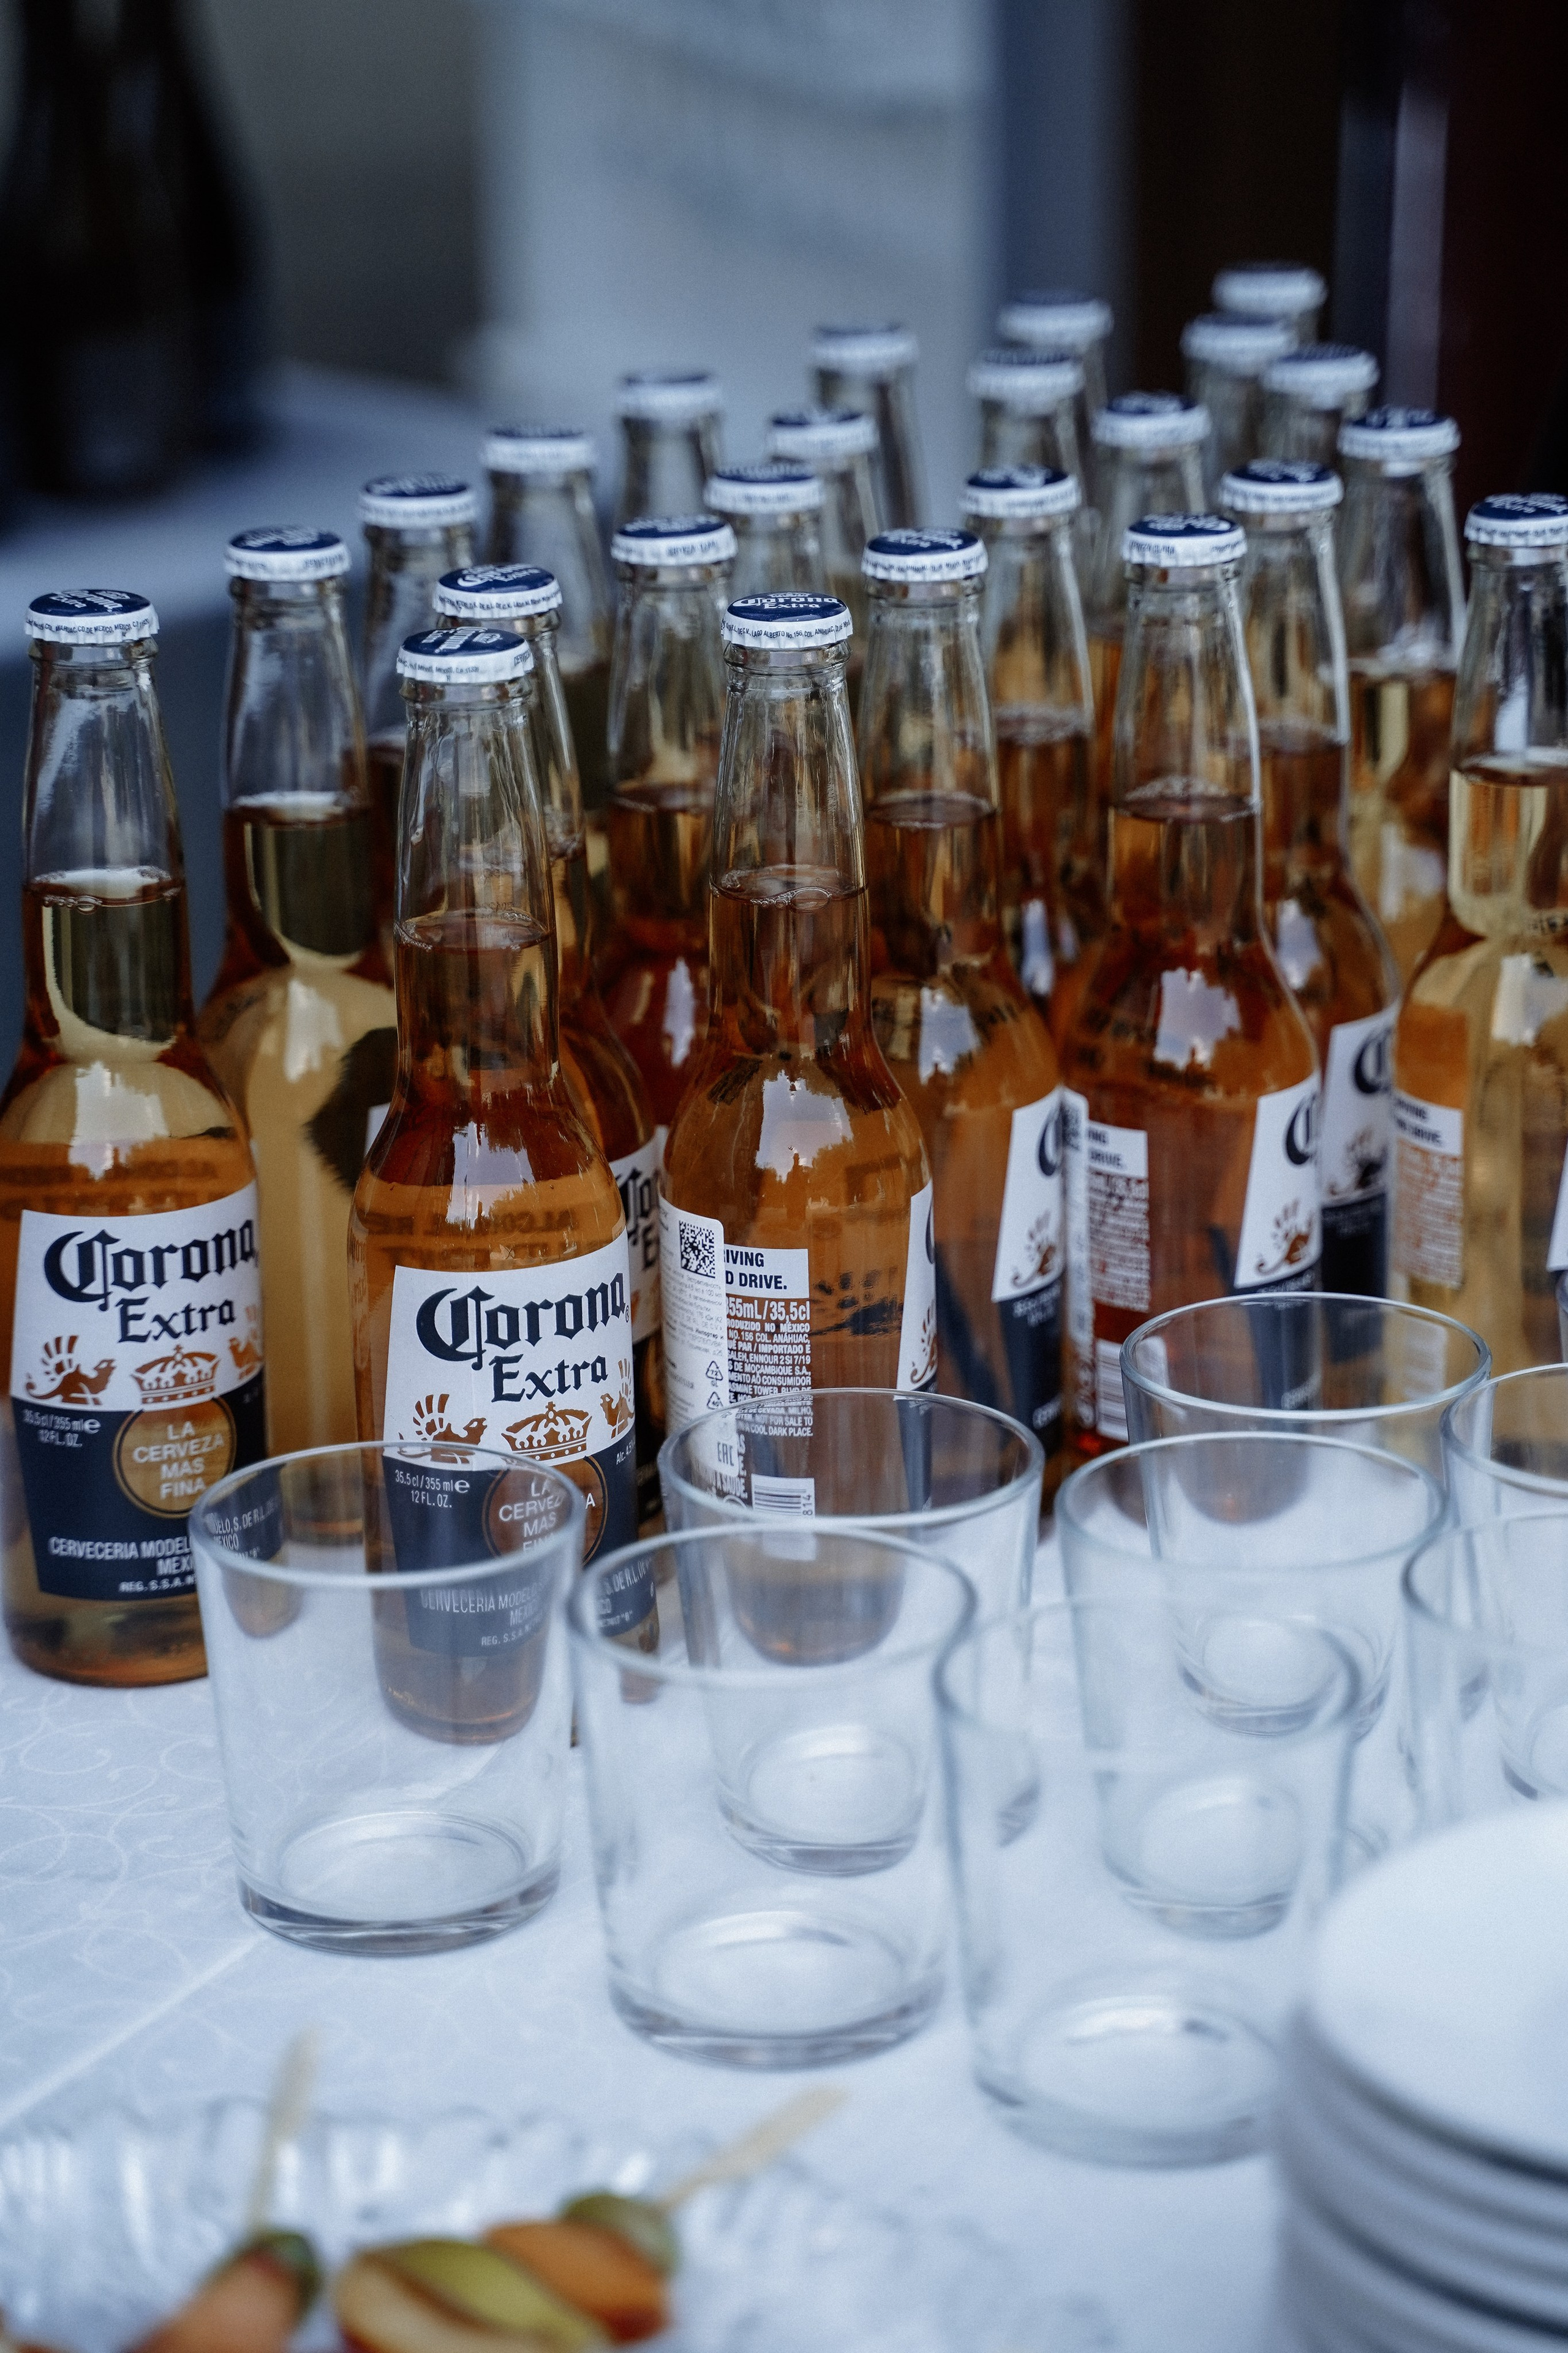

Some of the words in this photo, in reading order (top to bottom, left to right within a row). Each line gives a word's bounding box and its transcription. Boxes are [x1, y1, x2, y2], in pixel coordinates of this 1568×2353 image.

[733, 597, 839, 606] Corona
[763, 630, 785, 639] ALBERTO
[44, 1219, 255, 1312] Corona
[724, 1249, 764, 1267] IVING
[739, 1272, 787, 1290] DRIVE.
[115, 1297, 235, 1343] Extra
[416, 1272, 626, 1370] Corona
[764, 1323, 775, 1332] NO
[780, 1321, 810, 1332] MÉXICO
[741, 1331, 753, 1341] 156
[755, 1333, 771, 1343] COL.
[772, 1333, 810, 1345] ANÁHUAC,
[737, 1342, 752, 1352] PAR
[758, 1344, 804, 1354] IMPORTADO
[805, 1344, 811, 1354] E
[734, 1361, 743, 1372] DE
[749, 1353, 778, 1364] ENNOUR
[488, 1354, 609, 1402] Extra
[762, 1376, 811, 1386] CONSUMIDOR
[785, 1417, 802, 1426] SALE
[804, 1417, 813, 1426] TO
[167, 1421, 195, 1440] LA
[769, 1426, 787, 1436] DARK
[788, 1427, 813, 1437] PLACE.
[132, 1433, 224, 1464] CERVEZA
[160, 1457, 205, 1479] MAS
[160, 1477, 206, 1500] FINA
[437, 1494, 452, 1508] OZ.
[524, 1511, 557, 1538] MAS
[48, 1536, 138, 1560] CERVECERIA
[140, 1536, 194, 1558] MODEL
[481, 1636, 500, 1646] REG.
